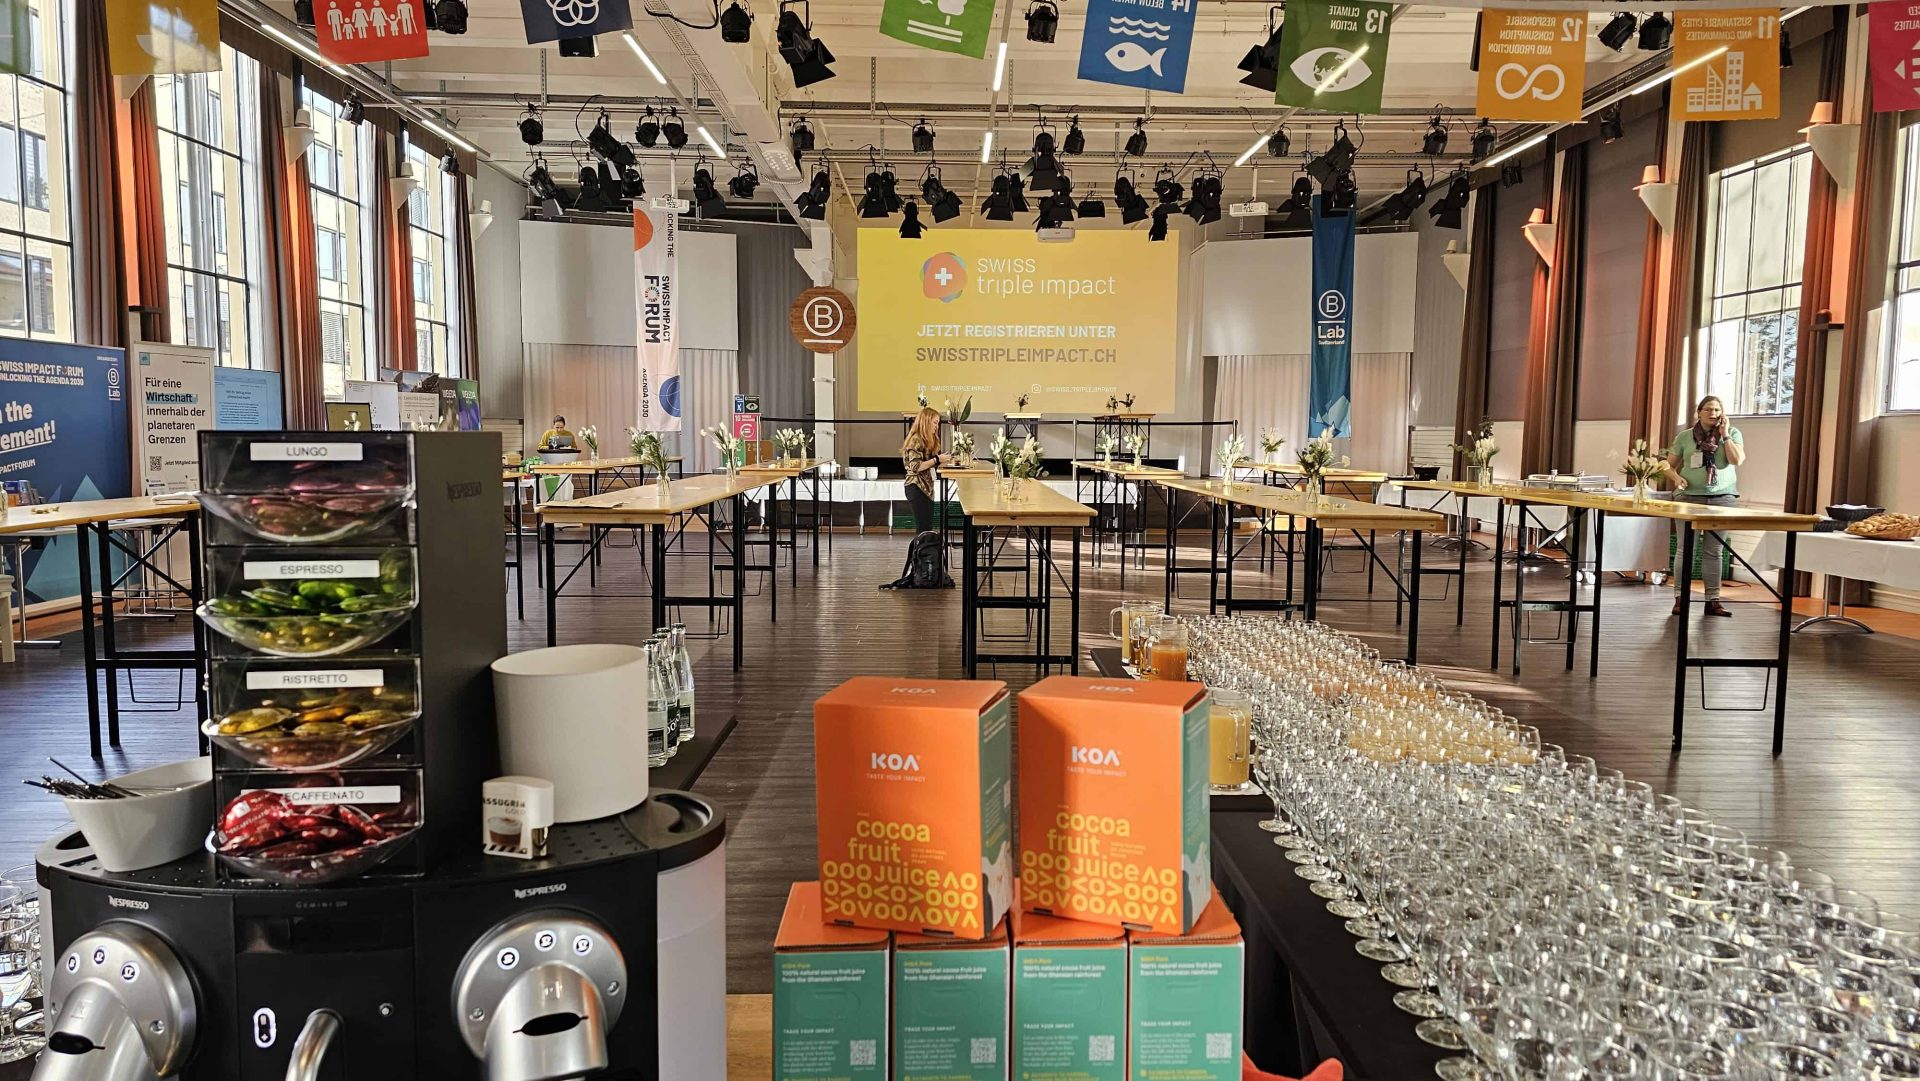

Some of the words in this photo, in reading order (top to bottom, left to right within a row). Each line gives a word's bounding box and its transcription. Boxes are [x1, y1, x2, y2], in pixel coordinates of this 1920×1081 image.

[977, 258, 1036, 273] SWISS
[662, 275, 670, 306] SWISS
[977, 274, 1034, 299] triple
[1041, 275, 1116, 300] impact
[662, 308, 670, 343] IMPACT
[917, 324, 961, 337] JETZT
[965, 325, 1065, 338] REGISTRIEREN
[1069, 325, 1116, 338] UNTER
[1318, 325, 1345, 339] Lab
[916, 347, 1117, 363] SWISSTRIPLEIMPACT.CH
[25, 363, 56, 376] IMPACT
[33, 375, 45, 384] THE
[46, 376, 69, 385] AGENDA
[70, 378, 84, 386] 2030
[145, 377, 161, 388] Für
[162, 379, 182, 388] eine
[108, 388, 120, 397] Lab
[146, 391, 192, 403] Wirtschaft
[5, 401, 33, 422] the
[147, 406, 189, 417] innerhalb
[190, 407, 205, 417] der
[148, 420, 195, 432] planetaren
[148, 434, 186, 444] Grenzen
[286, 447, 328, 457] LUNGO
[280, 565, 344, 575] ESPRESSO
[282, 674, 348, 684] RISTRETTO
[871, 752, 920, 771] KOA
[1072, 746, 1120, 766] KOA
[282, 790, 364, 801] ECAFFEINATO
[856, 820, 931, 843] cocoa
[1056, 812, 1130, 837] cocoa
[1047, 829, 1100, 857] fruit
[848, 837, 901, 864] fruit
[513, 883, 567, 899] NESPRESSO
[108, 895, 149, 910] NESPRESSO
